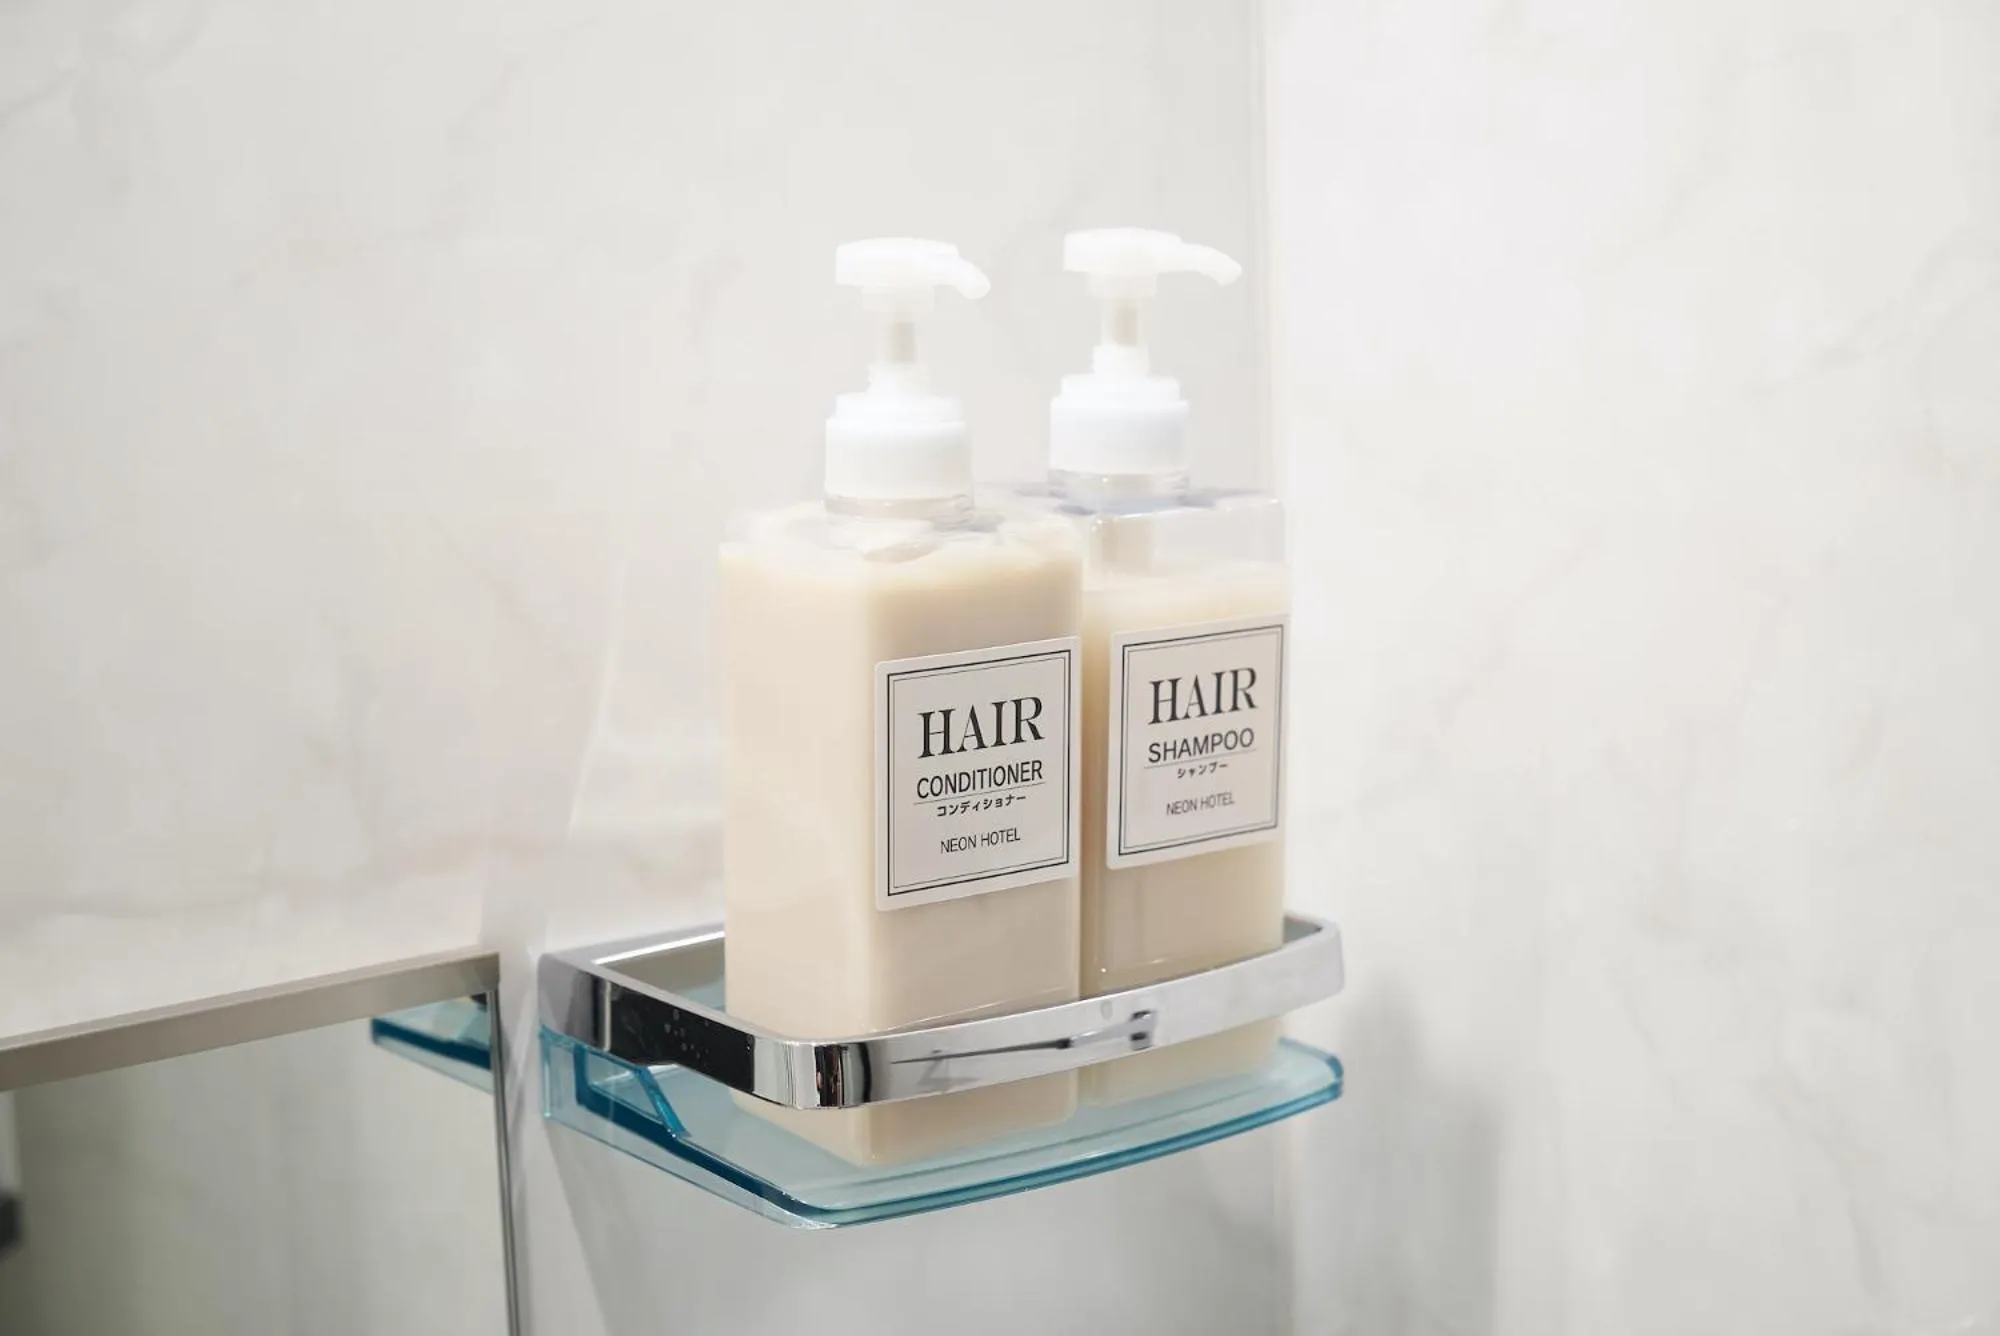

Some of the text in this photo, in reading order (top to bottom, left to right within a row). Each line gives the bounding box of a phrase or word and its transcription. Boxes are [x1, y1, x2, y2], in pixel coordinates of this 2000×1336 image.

[1148, 667, 1258, 725] HAIR
[917, 696, 1046, 759] HAIR
[1148, 728, 1254, 763] SHAMPOO
[916, 759, 1043, 799] CONDITIONER
[936, 794, 1027, 817] コンディショナー
[1166, 792, 1235, 816] NEON HOTEL
[940, 827, 1021, 854] NEON HOTEL
